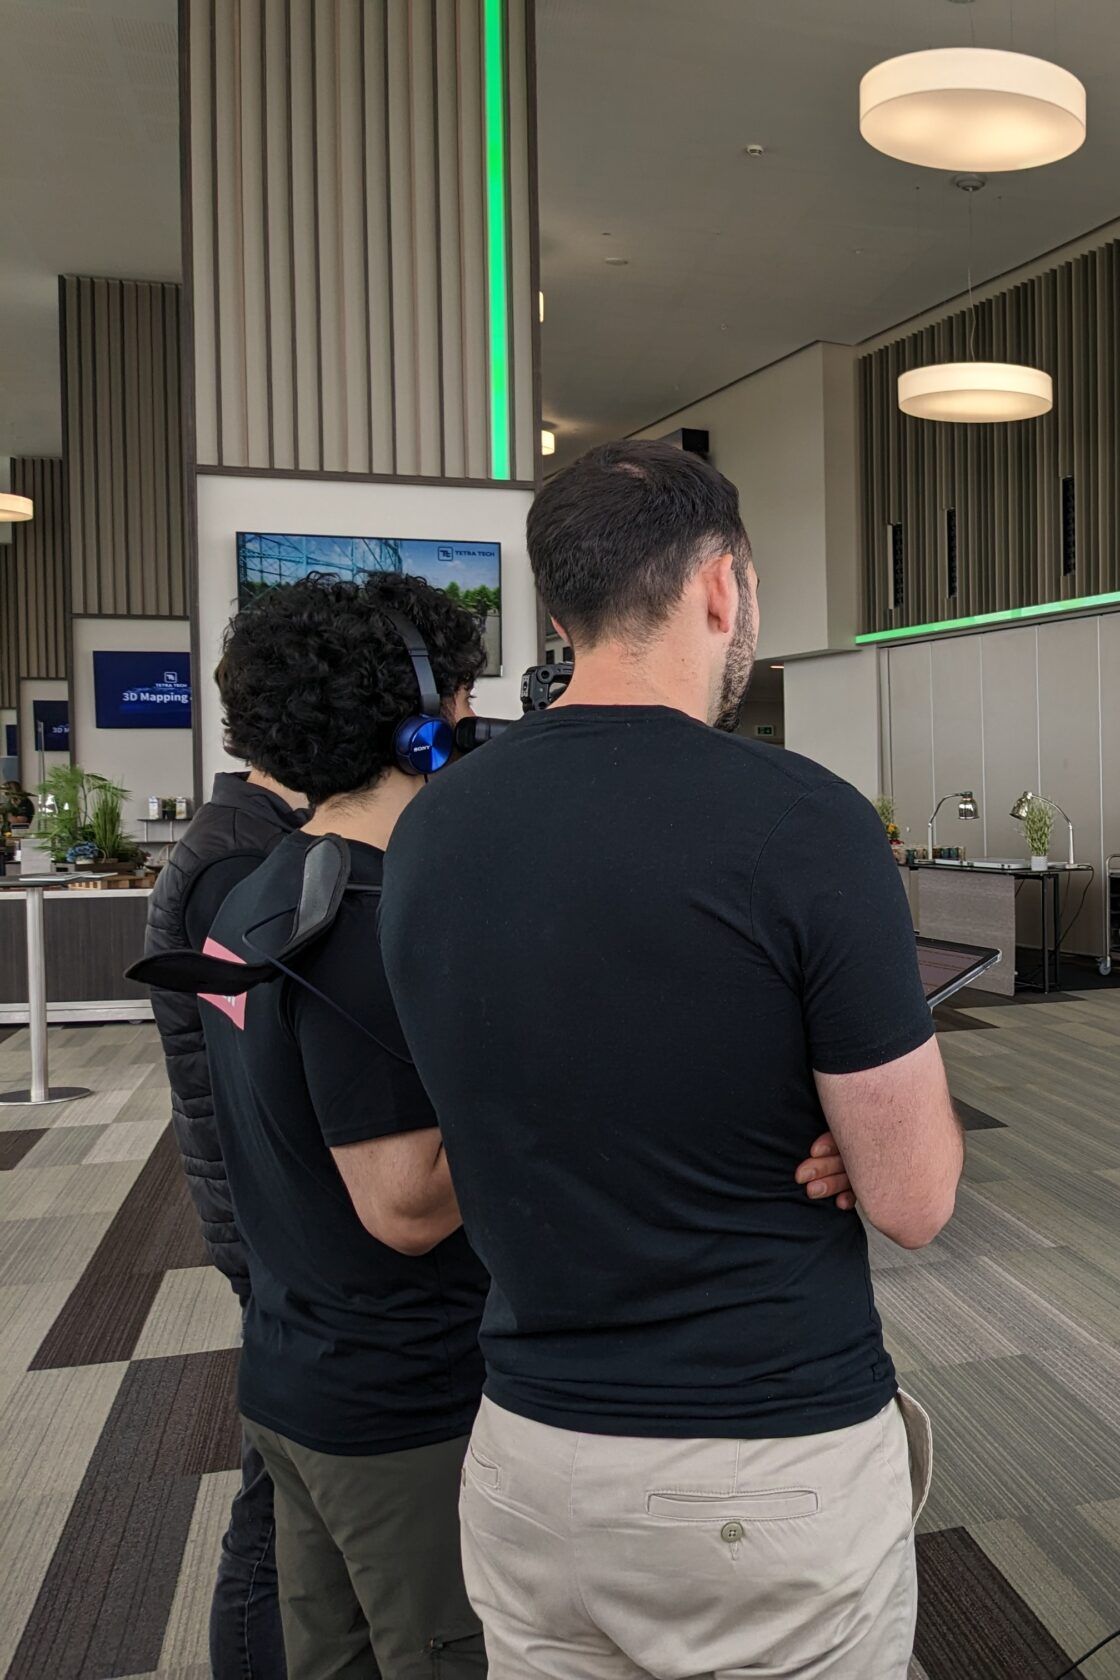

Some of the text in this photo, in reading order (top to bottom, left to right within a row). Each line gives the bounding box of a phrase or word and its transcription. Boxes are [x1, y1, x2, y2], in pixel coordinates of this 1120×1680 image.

[122, 691, 189, 704] 3D Mapping
[413, 745, 431, 753] SONY
